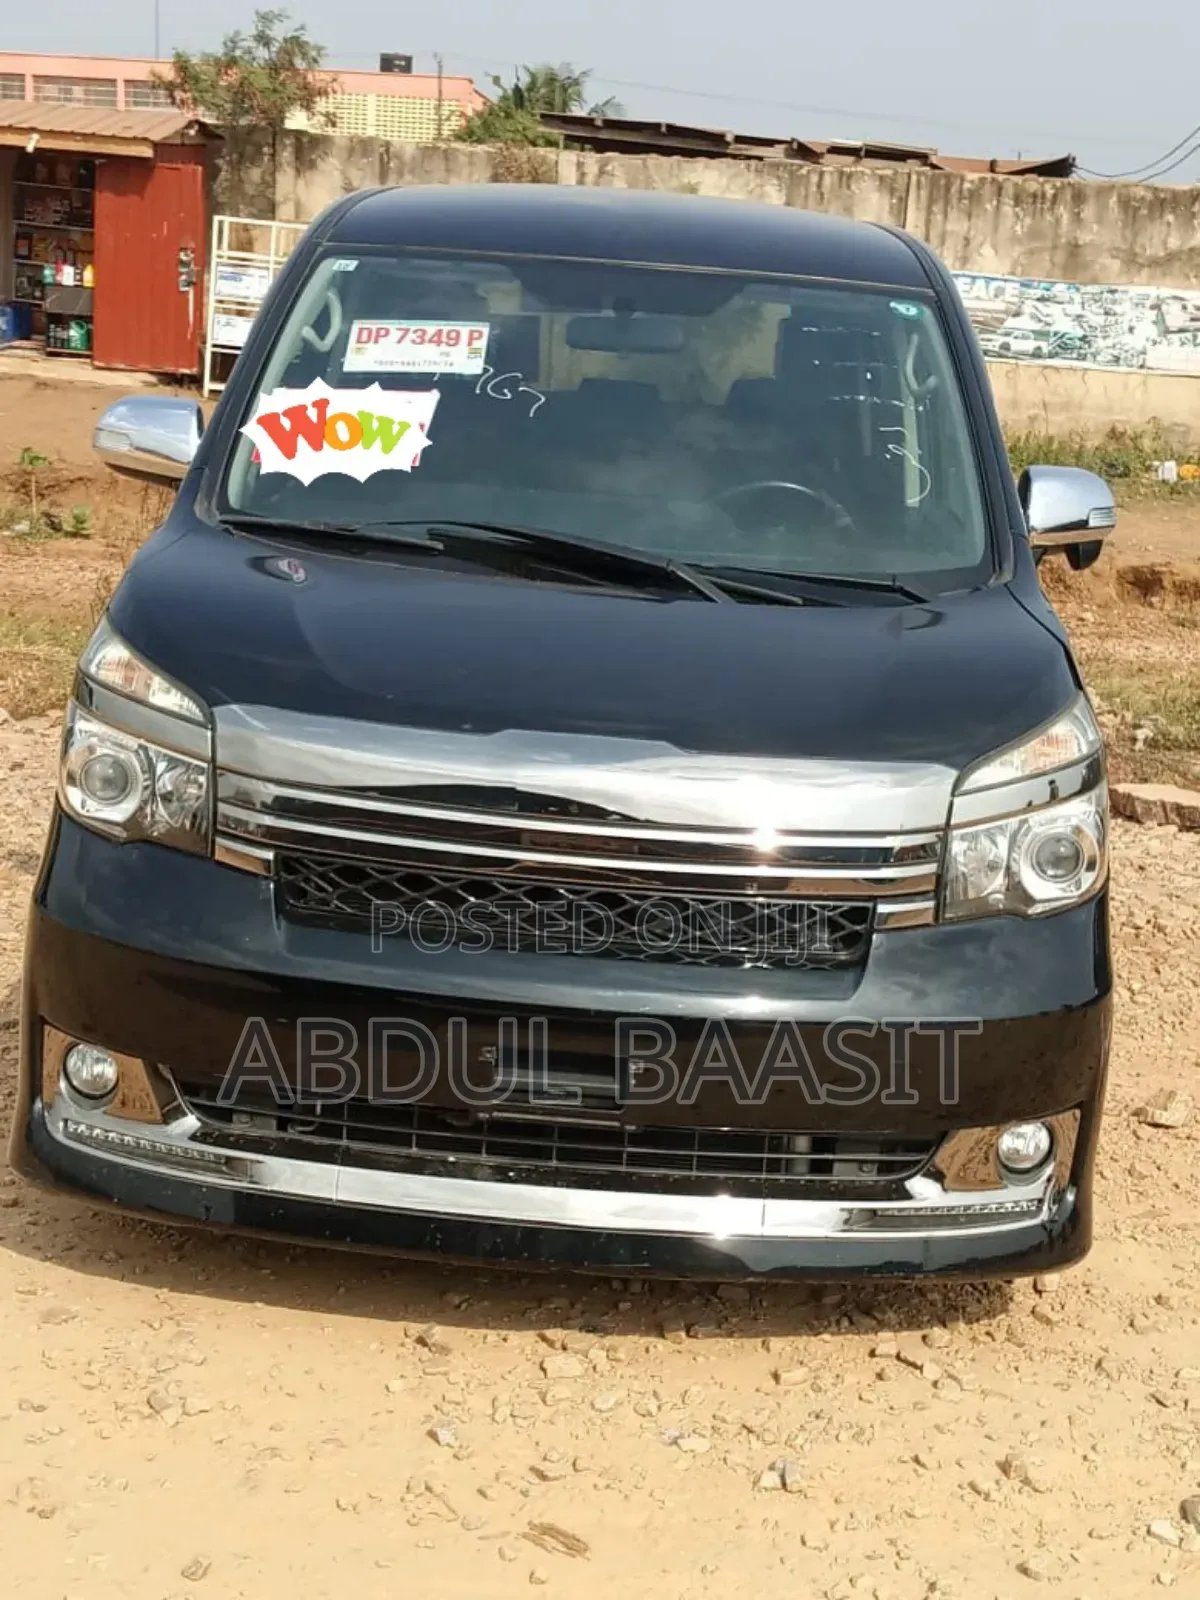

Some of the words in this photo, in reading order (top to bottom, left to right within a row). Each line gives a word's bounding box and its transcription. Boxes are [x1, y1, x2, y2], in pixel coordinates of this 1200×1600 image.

[955, 276, 1021, 302] EACE
[355, 326, 390, 345] DP
[395, 327, 461, 347] 7349
[467, 329, 485, 347] P
